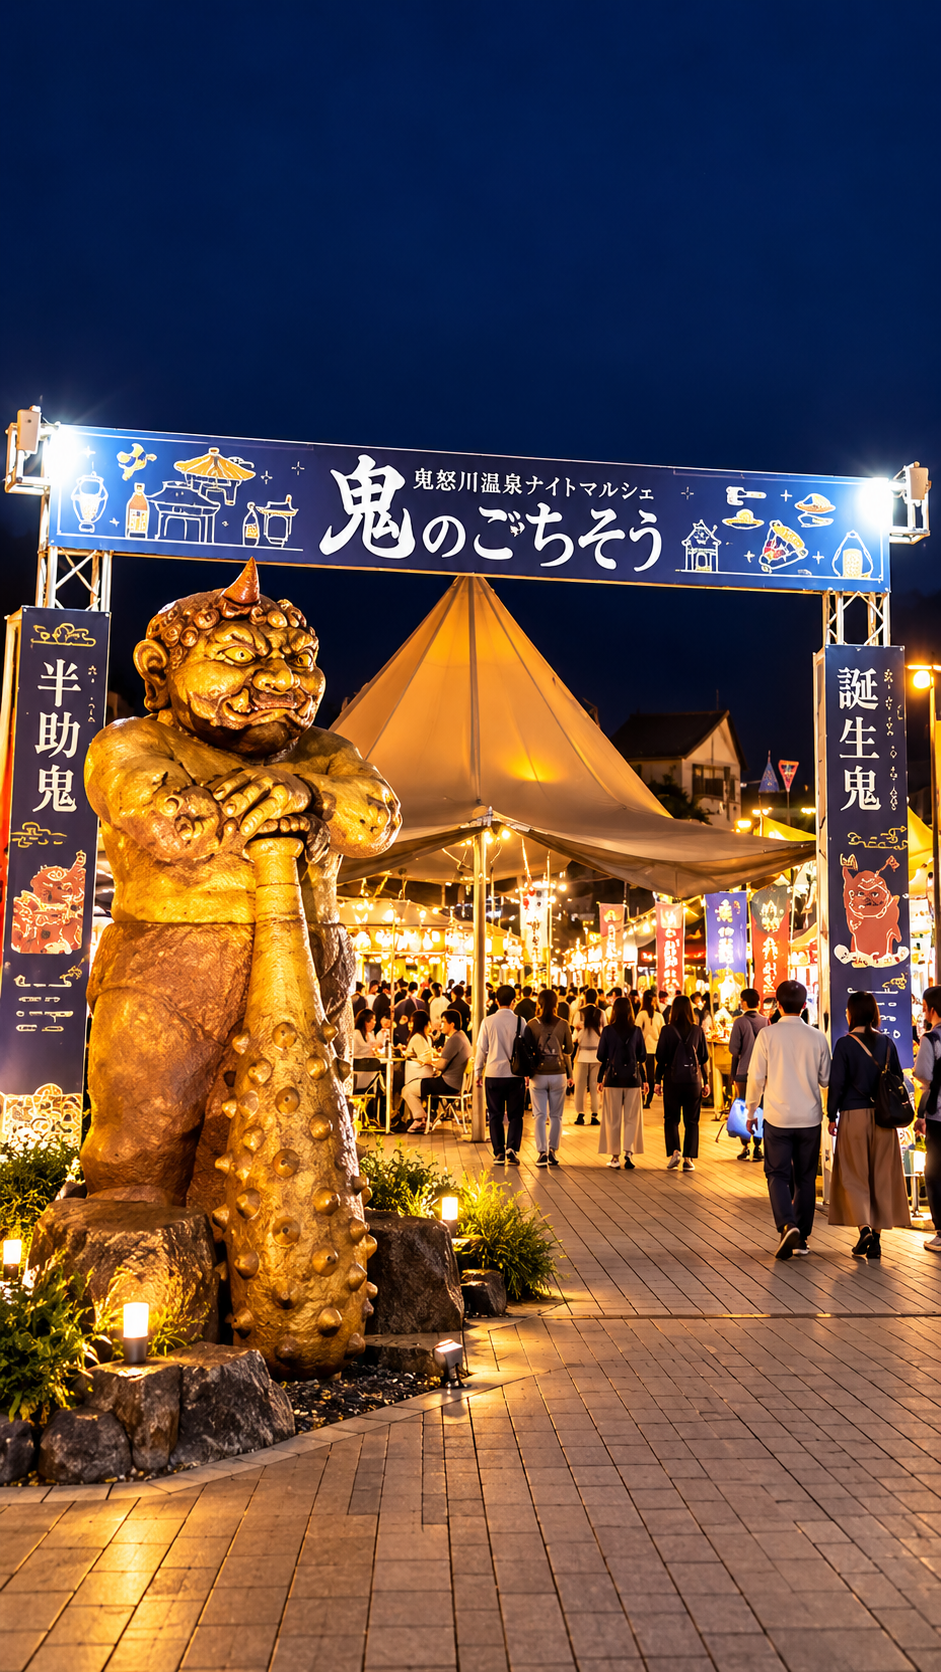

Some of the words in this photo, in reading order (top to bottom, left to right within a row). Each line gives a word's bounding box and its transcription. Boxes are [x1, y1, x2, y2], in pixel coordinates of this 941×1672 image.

[319, 454, 662, 572] 鬼のごちそう
[413, 467, 654, 500] 鬼怒川温泉ナイトマルシェ
[33, 658, 82, 813] 半助鬼
[836, 666, 882, 811] 誕生鬼
